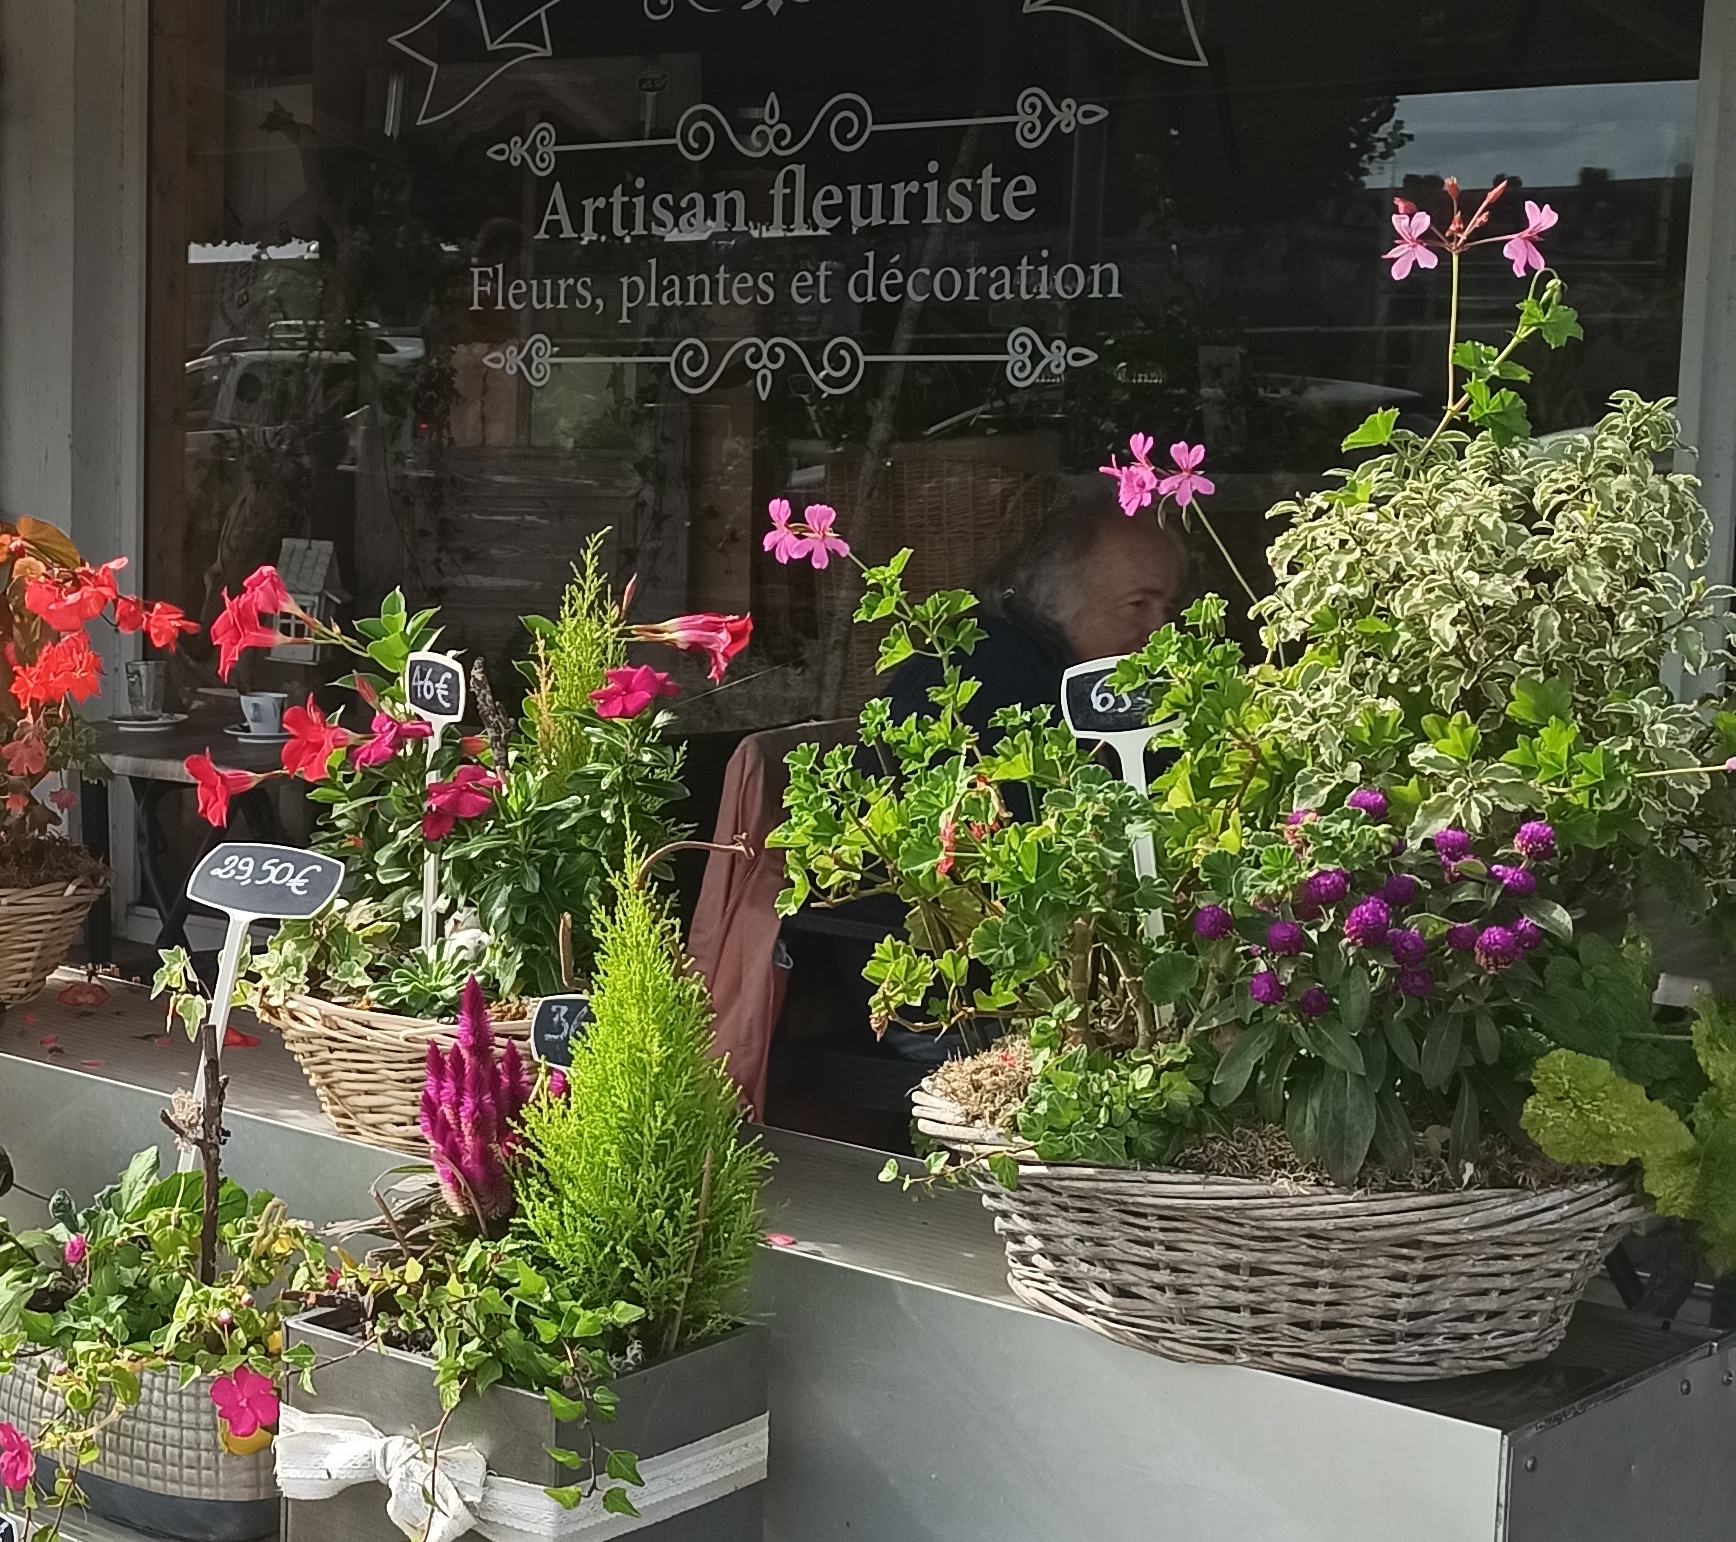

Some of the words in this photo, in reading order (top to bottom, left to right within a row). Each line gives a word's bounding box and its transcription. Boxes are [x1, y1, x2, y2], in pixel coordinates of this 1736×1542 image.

[534, 176, 747, 239] Artisan
[770, 161, 1038, 232] fleuriste
[469, 262, 605, 314] Fleurs,
[618, 257, 775, 322] plantes
[790, 264, 832, 304] et
[847, 249, 1123, 303] décoration
[411, 664, 453, 709] 46€
[210, 855, 322, 896] 29,50€
